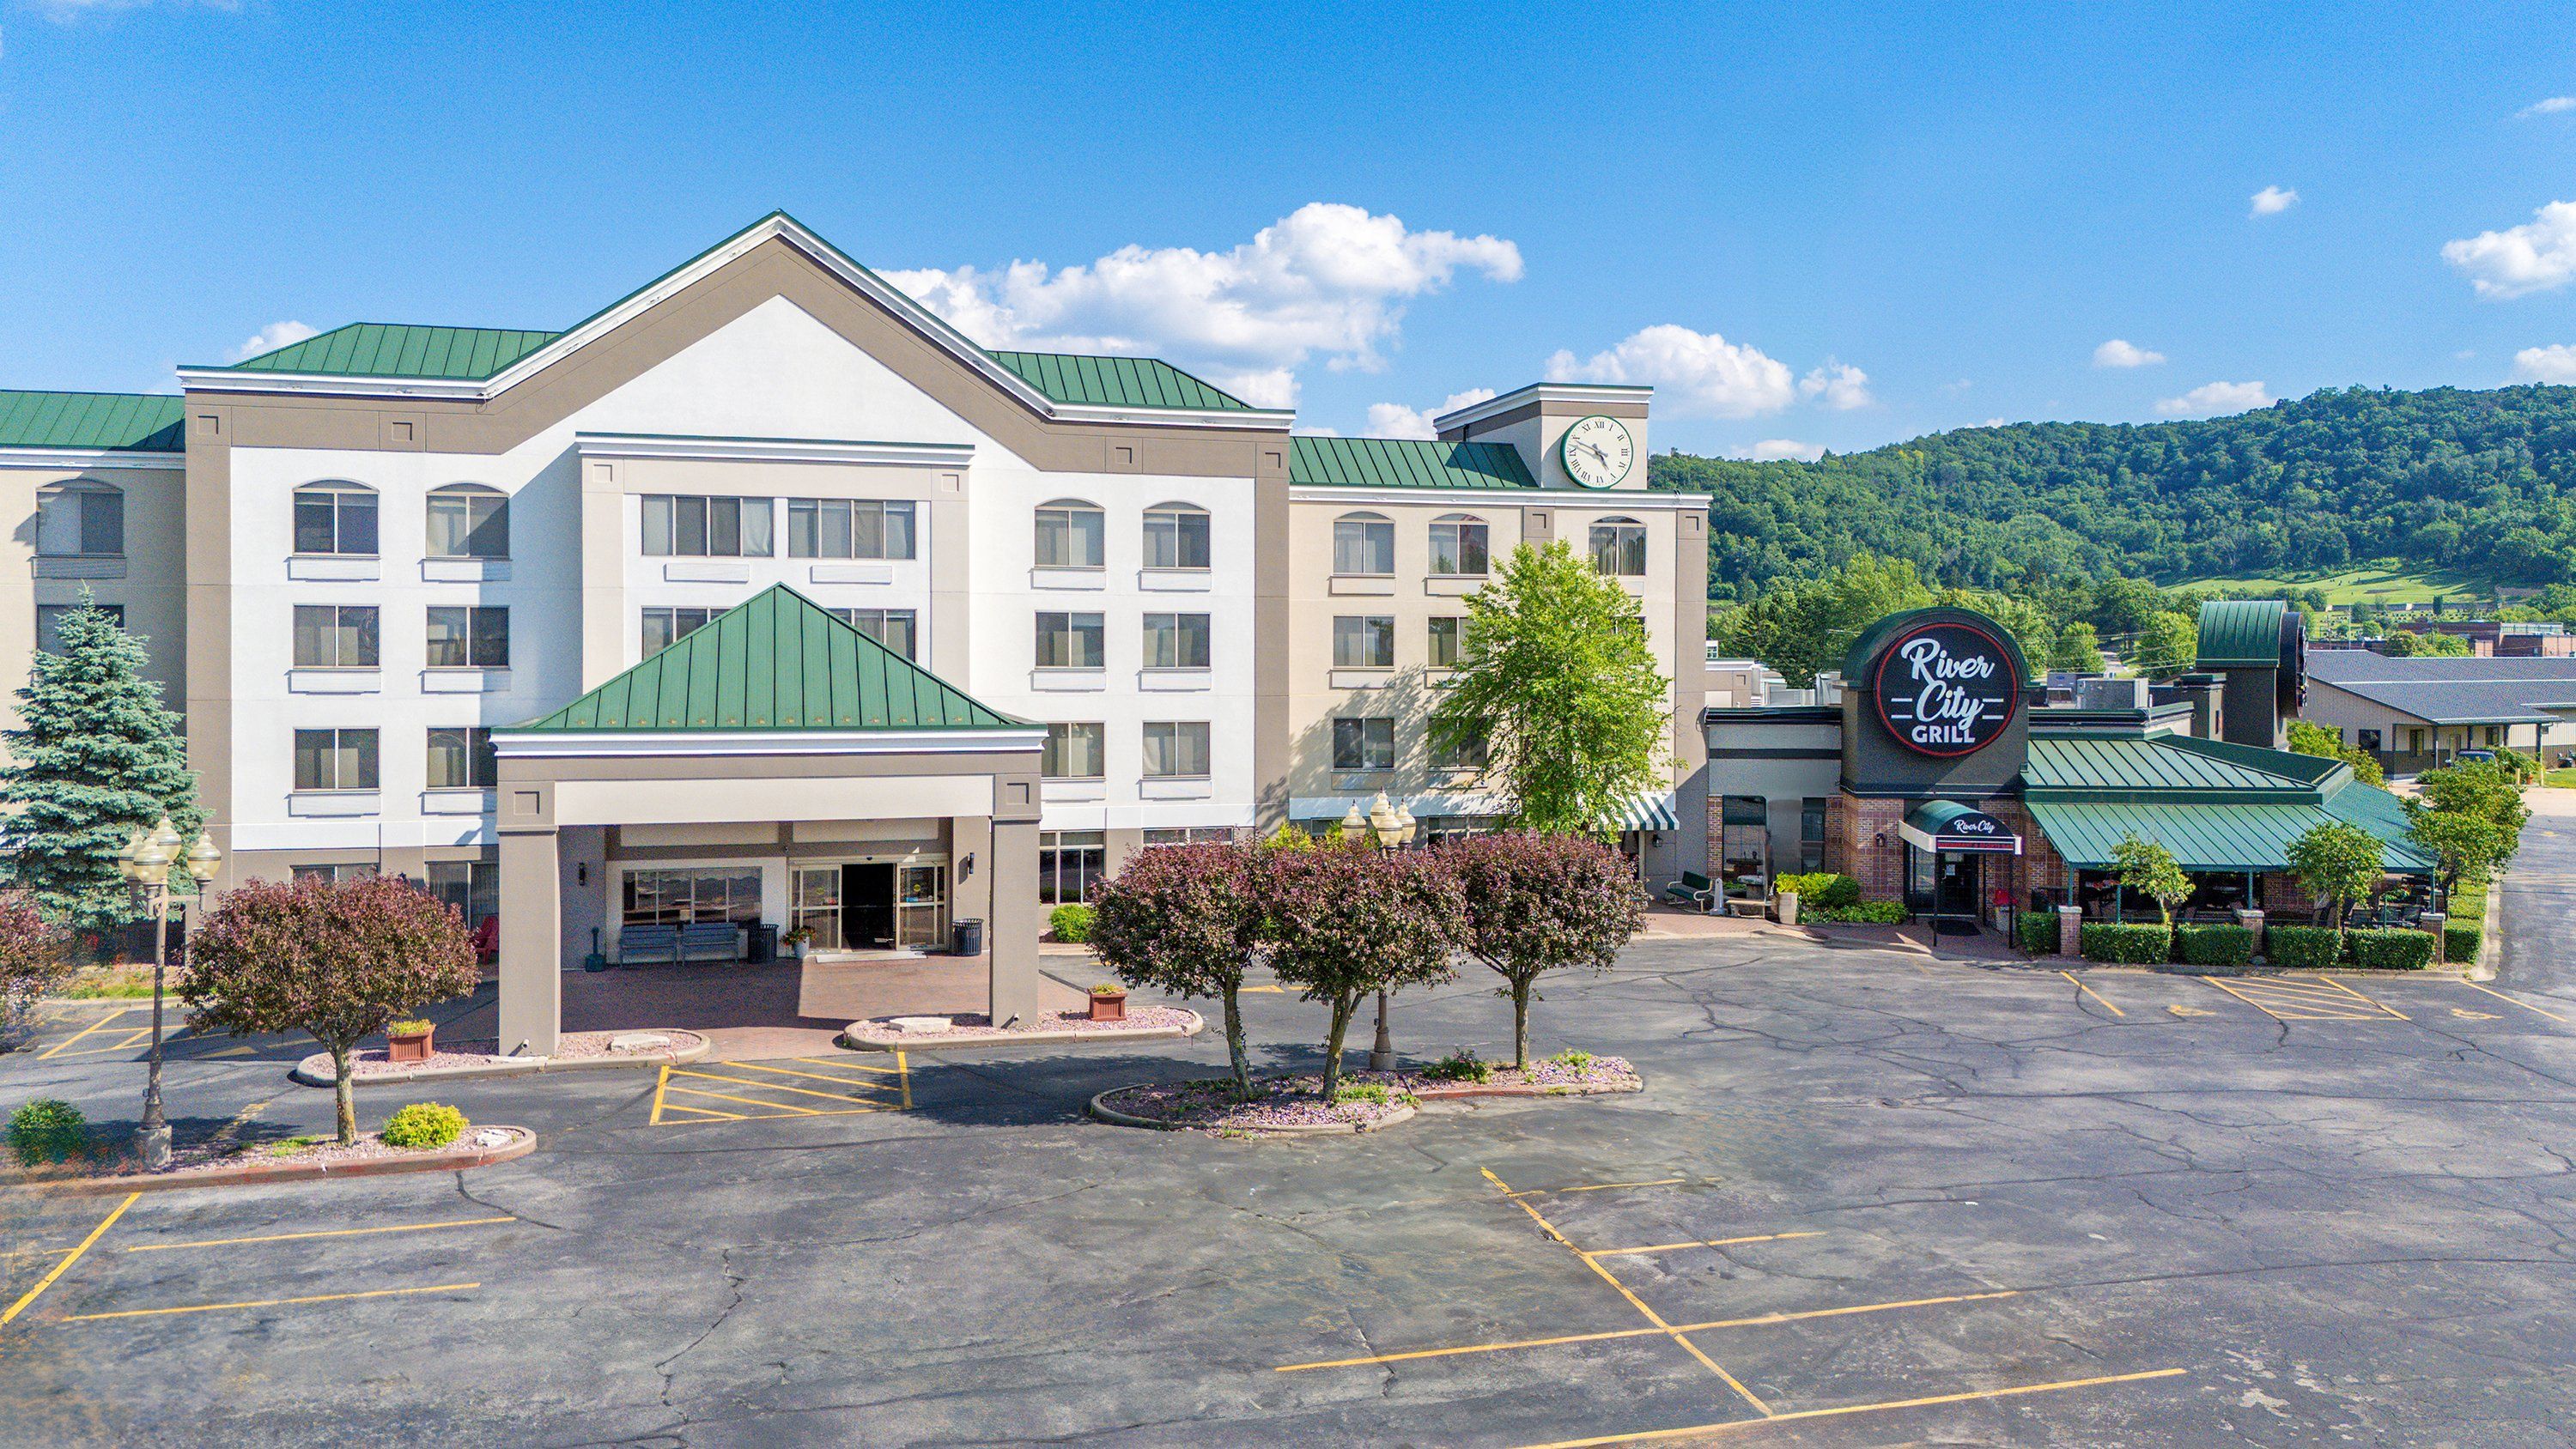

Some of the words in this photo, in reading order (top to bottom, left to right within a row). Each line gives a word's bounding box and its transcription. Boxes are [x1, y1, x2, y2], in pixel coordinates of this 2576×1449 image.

[1900, 638, 1996, 684] River
[1916, 680, 1984, 730] City
[1911, 725, 1976, 743] GRILL
[1953, 819, 1978, 834] River
[1978, 820, 1996, 834] City
